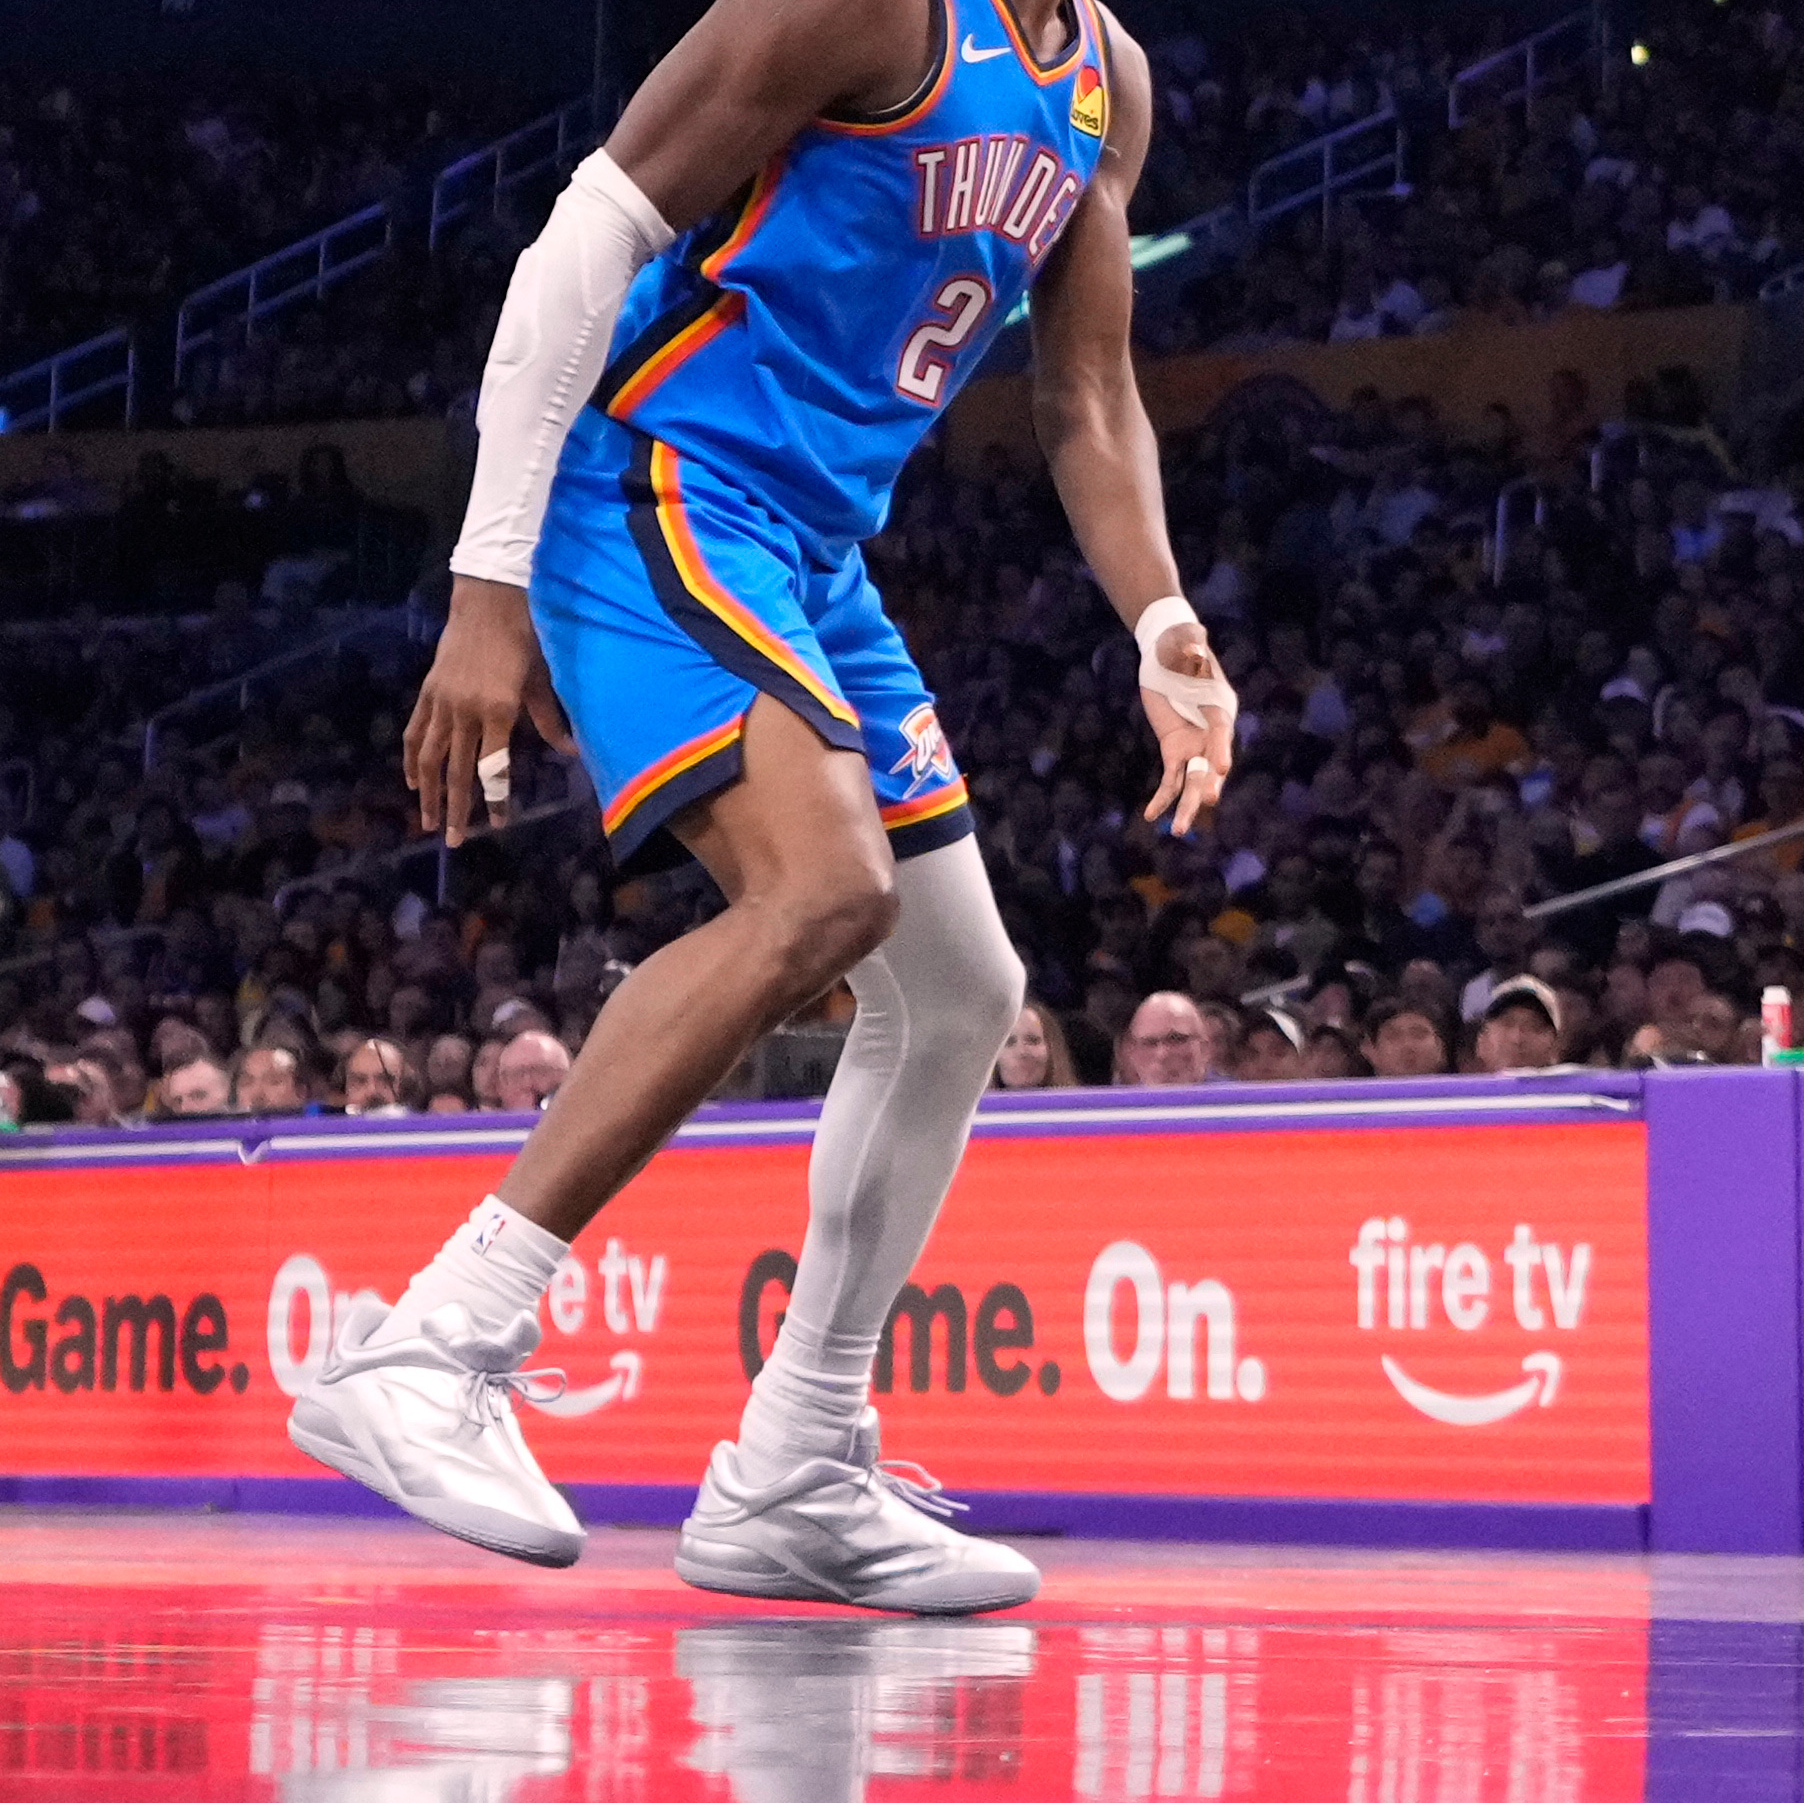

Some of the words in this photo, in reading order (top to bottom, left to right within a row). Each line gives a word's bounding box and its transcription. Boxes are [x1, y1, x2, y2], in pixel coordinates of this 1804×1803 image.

[917, 141, 1077, 264] THUNDE
[897, 279, 986, 400] 2
[0, 1262, 249, 1394] Game.
[598, 1237, 667, 1334] tv
[739, 1249, 1061, 1397] Gme.
[1083, 1239, 1266, 1402] On.
[1349, 1216, 1491, 1332] fire
[1504, 1224, 1592, 1332] tv
